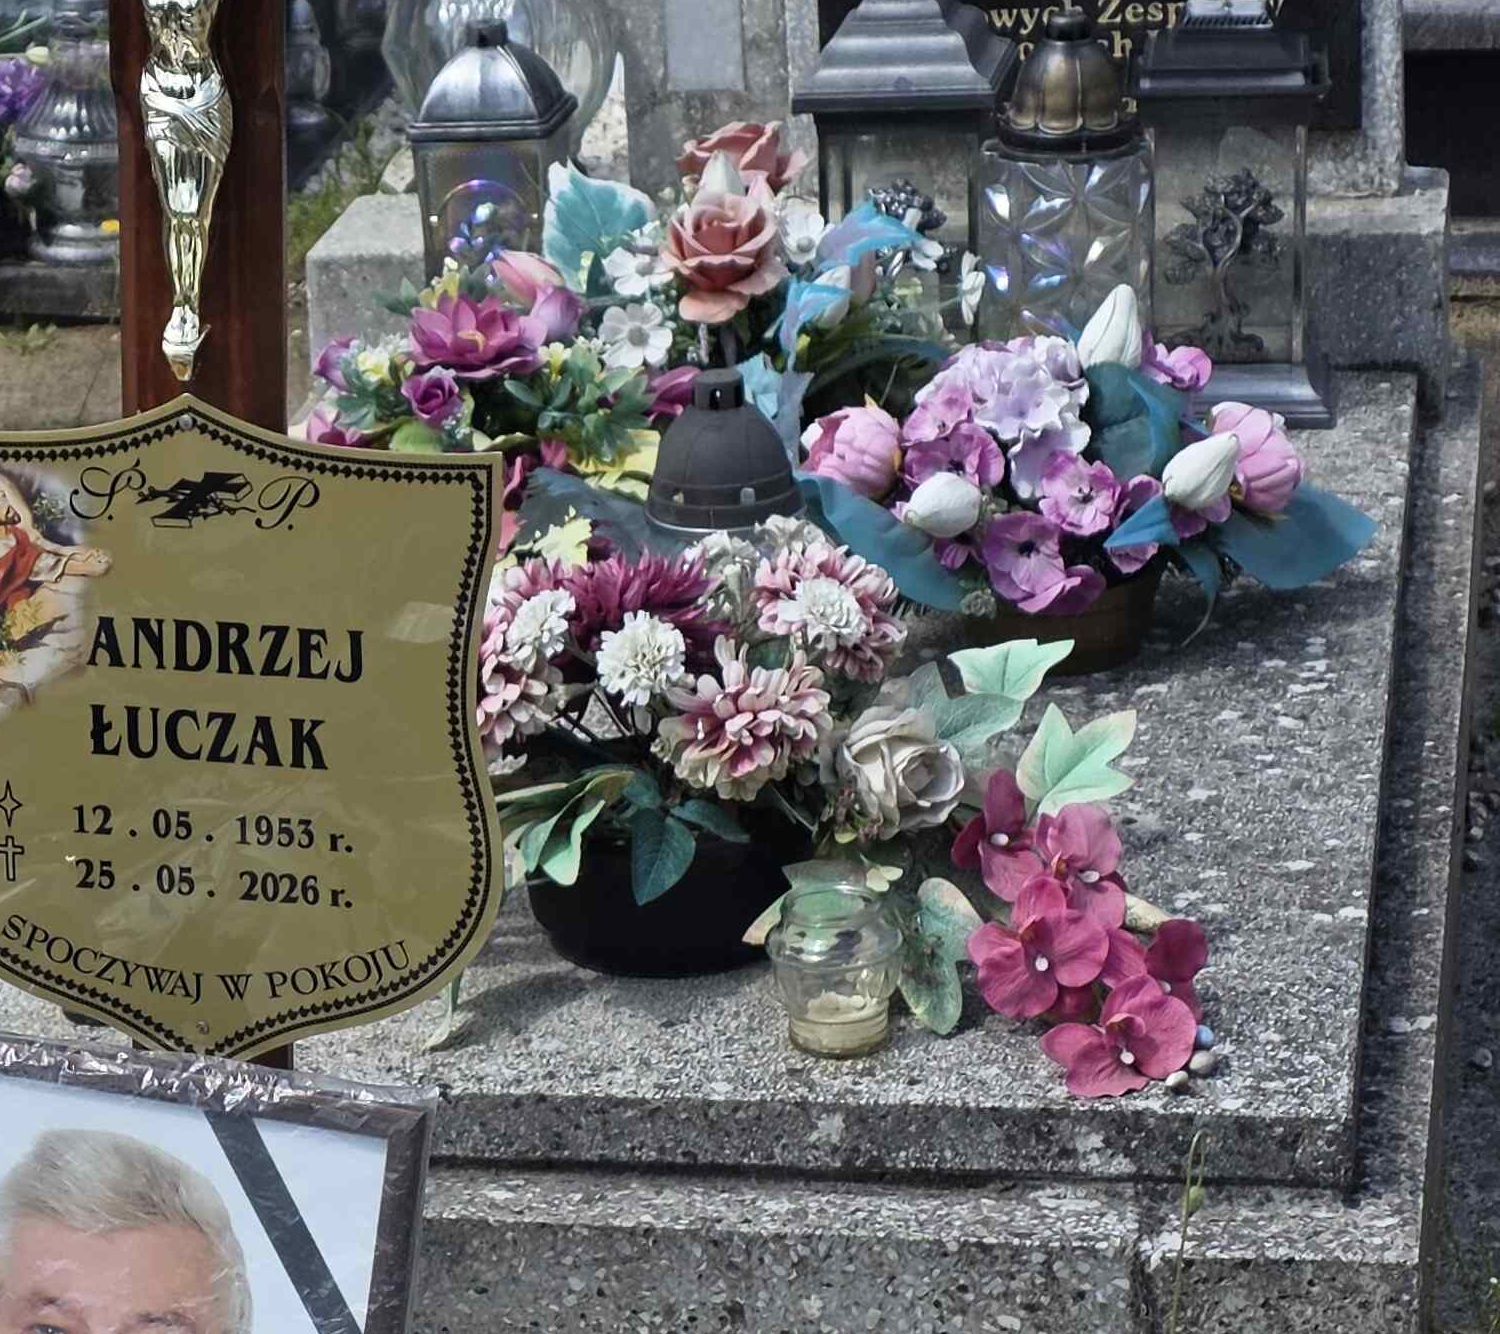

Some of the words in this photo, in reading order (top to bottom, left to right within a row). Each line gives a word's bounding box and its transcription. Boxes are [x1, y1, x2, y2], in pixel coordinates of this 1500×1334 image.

[87, 615, 365, 683] ANDRZEJ
[89, 703, 329, 771] ŁUCZAK
[2, 914, 204, 1005] SPOCZYWAJ
[216, 972, 254, 1002] W
[266, 938, 413, 1001] POKOJU
